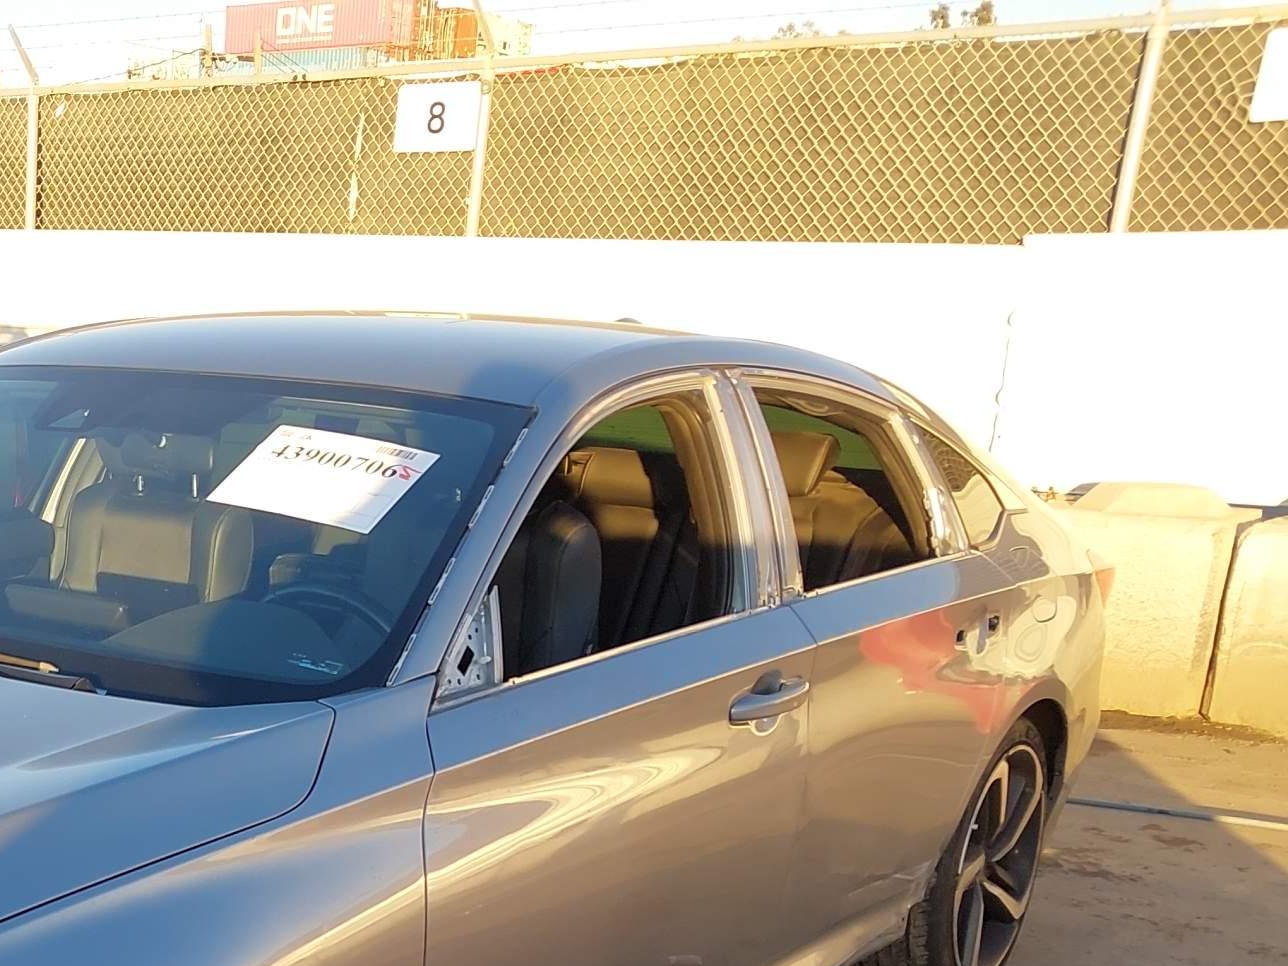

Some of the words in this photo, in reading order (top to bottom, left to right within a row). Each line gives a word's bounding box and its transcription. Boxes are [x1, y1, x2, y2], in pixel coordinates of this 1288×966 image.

[276, 3, 336, 37] ONE
[427, 101, 446, 134] 8
[272, 444, 399, 478] 43900706
